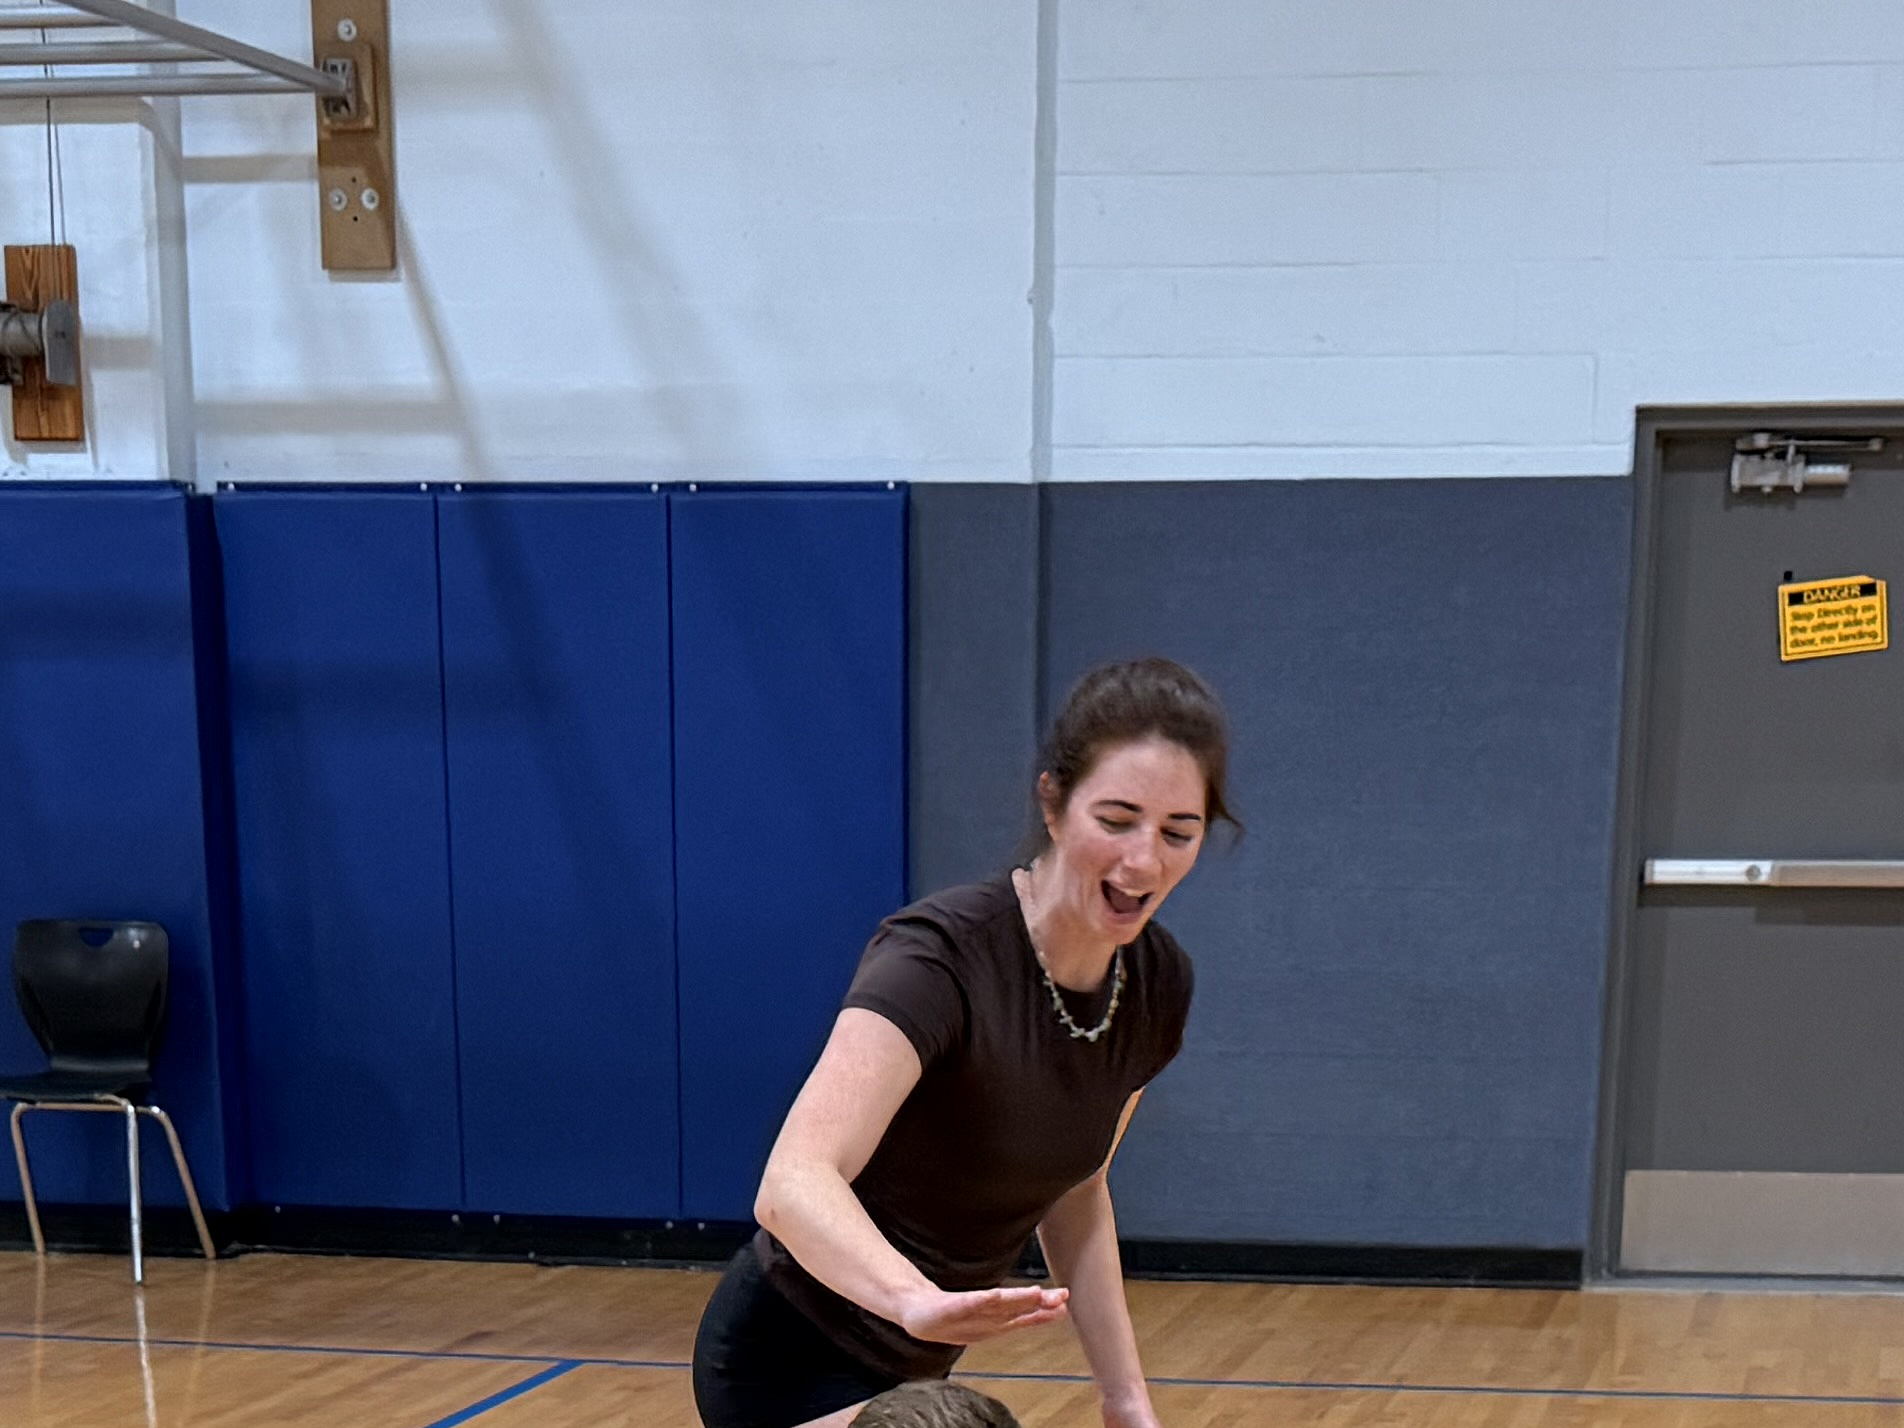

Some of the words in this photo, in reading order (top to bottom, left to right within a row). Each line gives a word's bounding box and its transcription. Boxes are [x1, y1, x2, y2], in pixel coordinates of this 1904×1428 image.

[1802, 584, 1862, 604] DANGER
[1789, 625, 1808, 635] the
[1810, 620, 1839, 633] other
